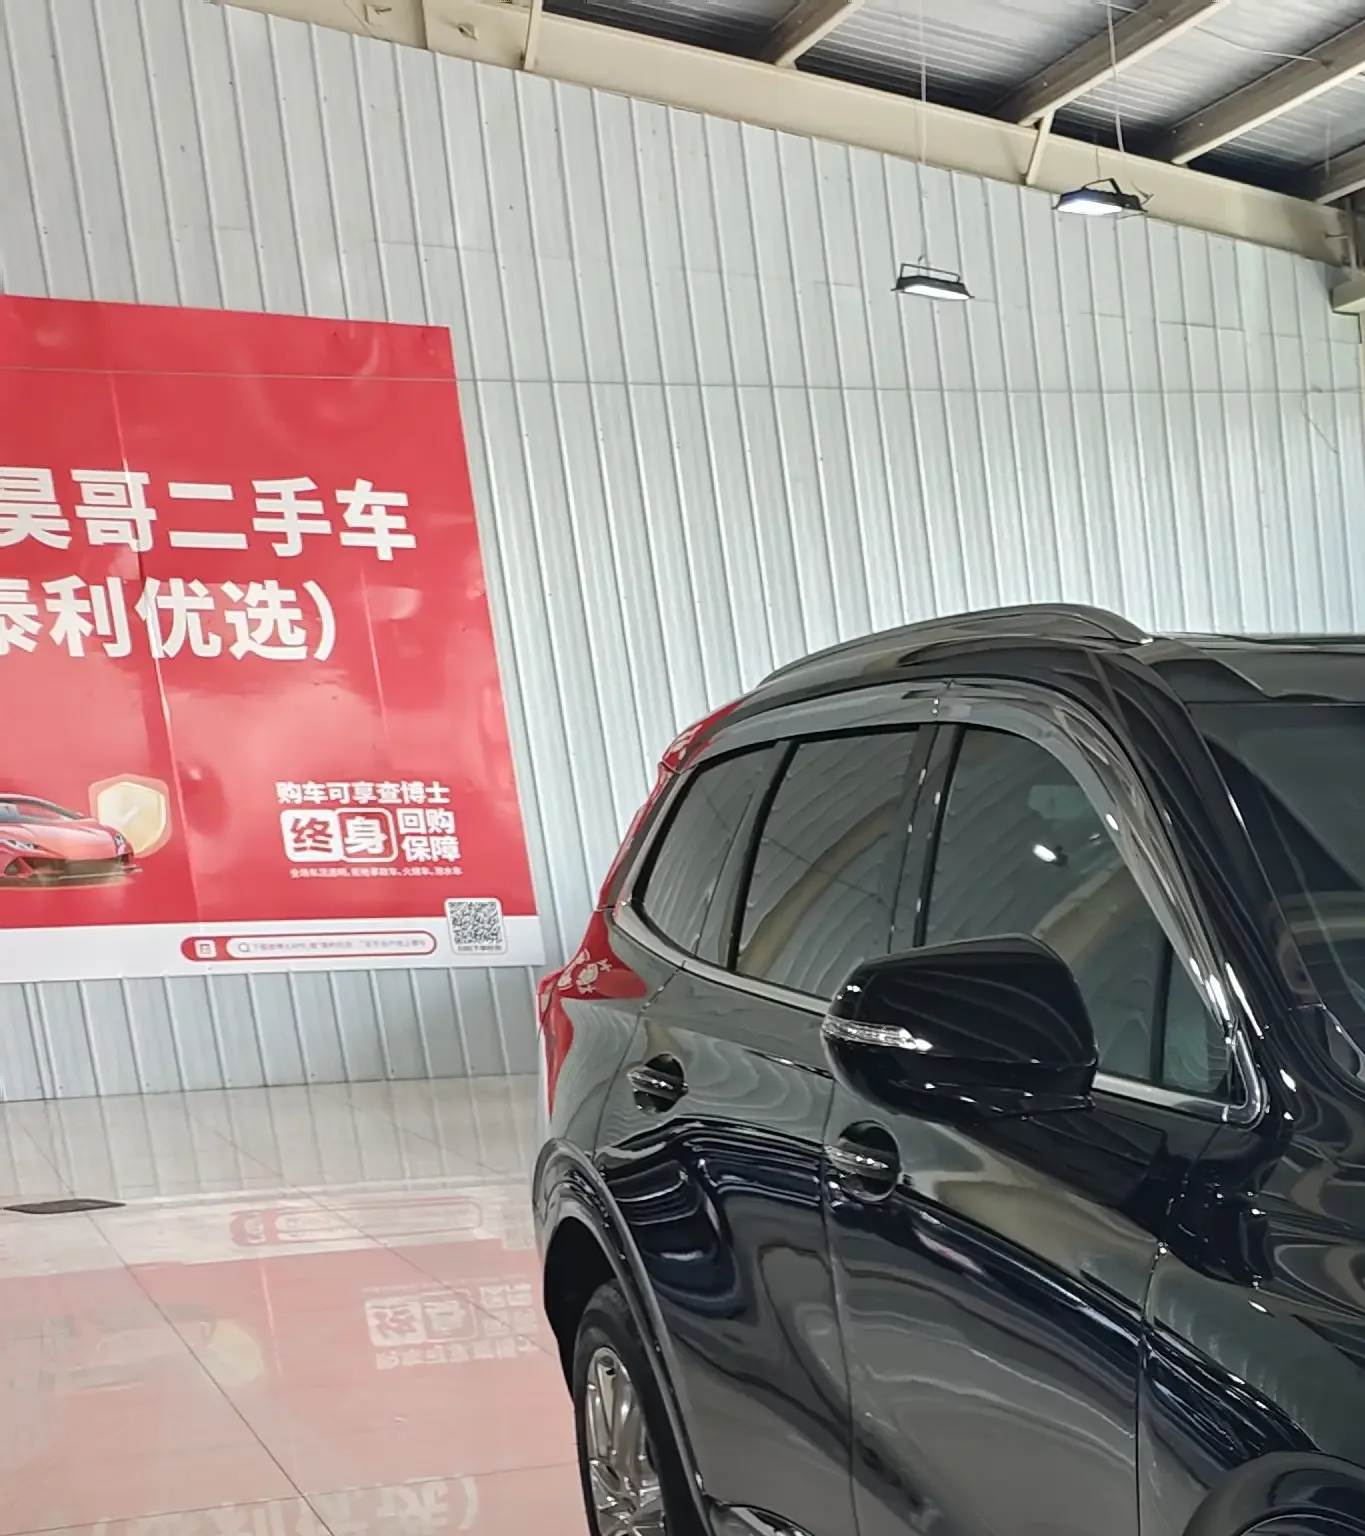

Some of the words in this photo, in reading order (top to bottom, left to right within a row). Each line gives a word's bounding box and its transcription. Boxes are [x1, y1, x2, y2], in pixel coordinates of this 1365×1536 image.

[0, 464, 417, 562] 昊哥二手车
[275, 780, 451, 804] 购车可享查博士
[396, 807, 456, 834] 回购
[290, 815, 388, 855] 终身
[401, 835, 462, 862] 保障
